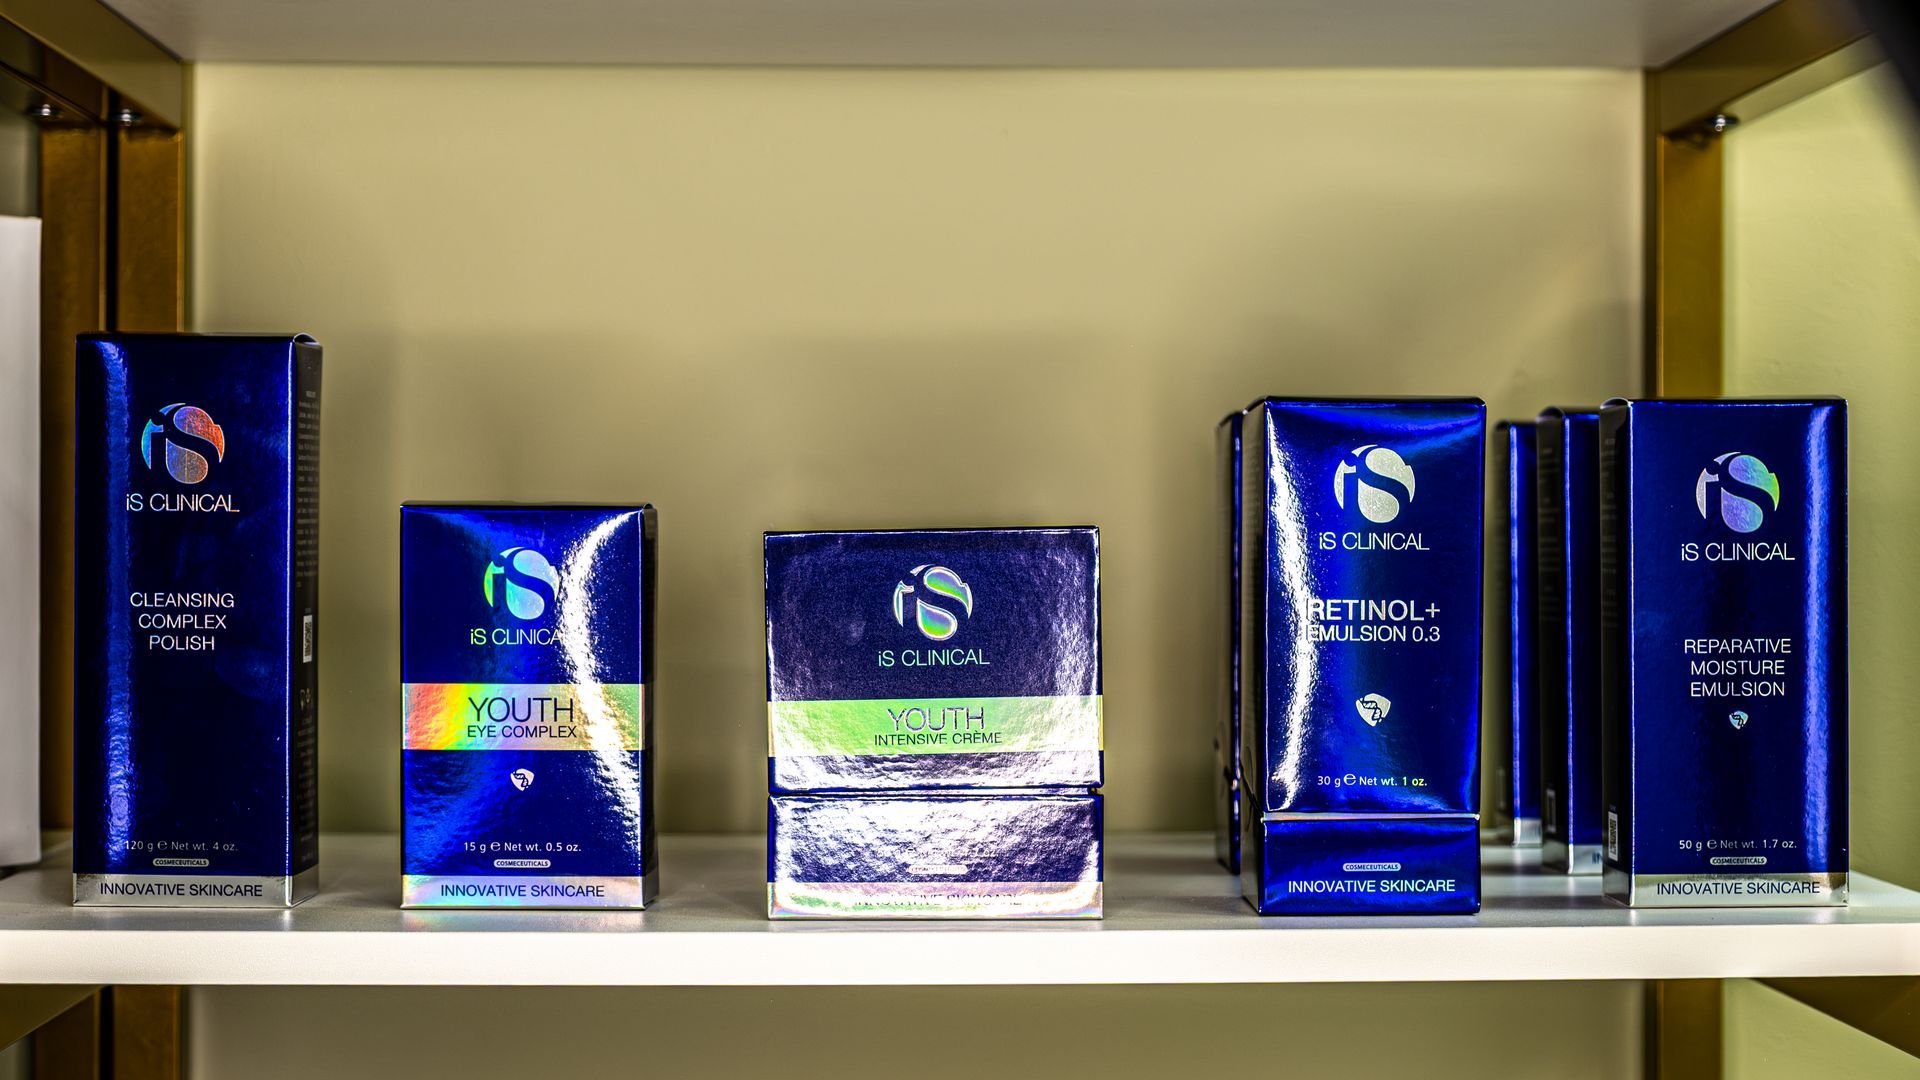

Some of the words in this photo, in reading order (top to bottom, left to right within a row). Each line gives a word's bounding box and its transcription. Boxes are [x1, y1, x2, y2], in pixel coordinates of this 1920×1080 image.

[126, 493, 143, 512] iS
[150, 493, 240, 513] CLINICAL
[1319, 532, 1337, 550] iS
[1342, 532, 1430, 551] CLINICAL
[1681, 543, 1699, 561] iS
[1705, 543, 1795, 561] CLINICAL
[130, 592, 235, 608] CLEANSING
[1306, 599, 1440, 621] RETINOL+
[138, 614, 227, 629] COMPLEX
[470, 628, 487, 645] iS
[491, 628, 563, 645] CLINICA
[1306, 625, 1406, 642] EMULSION
[1412, 625, 1440, 642] 0.3
[149, 635, 215, 651] POLISH
[1684, 638, 1791, 654] REPARATIVE
[878, 650, 895, 667] iS
[902, 648, 990, 667] CLINICAL
[1691, 660, 1785, 675] MOISTURE
[1691, 682, 1785, 697] EMULSION
[468, 697, 573, 722] YOUTH
[887, 707, 986, 732] YOUTH
[468, 726, 498, 738] EYE
[502, 725, 577, 738] COMPLEX
[874, 732, 949, 746] INTENSIVE
[952, 730, 1003, 744] CRÈME
[1317, 775, 1331, 786] 30
[1334, 777, 1341, 788] g
[1359, 775, 1377, 786] Net
[1380, 775, 1397, 786] wt.
[1402, 776, 1407, 786] 1
[1411, 778, 1428, 787] oz.
[125, 841, 143, 850] 120
[147, 843, 154, 852] g
[171, 841, 189, 851] Net
[192, 842, 209, 851] wt.
[212, 842, 219, 851] 4
[222, 843, 238, 851] oz.
[464, 842, 476, 852] 15
[480, 843, 487, 854] g
[504, 842, 522, 852] Net
[525, 842, 542, 852] wt.
[545, 842, 563, 852] 0.5
[566, 844, 582, 852] oz.
[1679, 839, 1692, 849] 50
[1695, 841, 1702, 851] g
[1720, 839, 1738, 849] Net
[1741, 840, 1758, 849] wt.
[1763, 839, 1778, 849] 1.7
[1781, 840, 1797, 849] oz.
[100, 883, 185, 897] INNOVATIVE
[189, 883, 263, 897] SKINCARE
[441, 884, 527, 897] INNOVATIVE
[530, 885, 605, 897] SKINCARE
[1288, 880, 1376, 893] INNOVATIVE
[1379, 879, 1456, 893] SKINCARE
[1657, 882, 1742, 895] INNOVATIVE
[1747, 881, 1820, 895] SKINCARE
